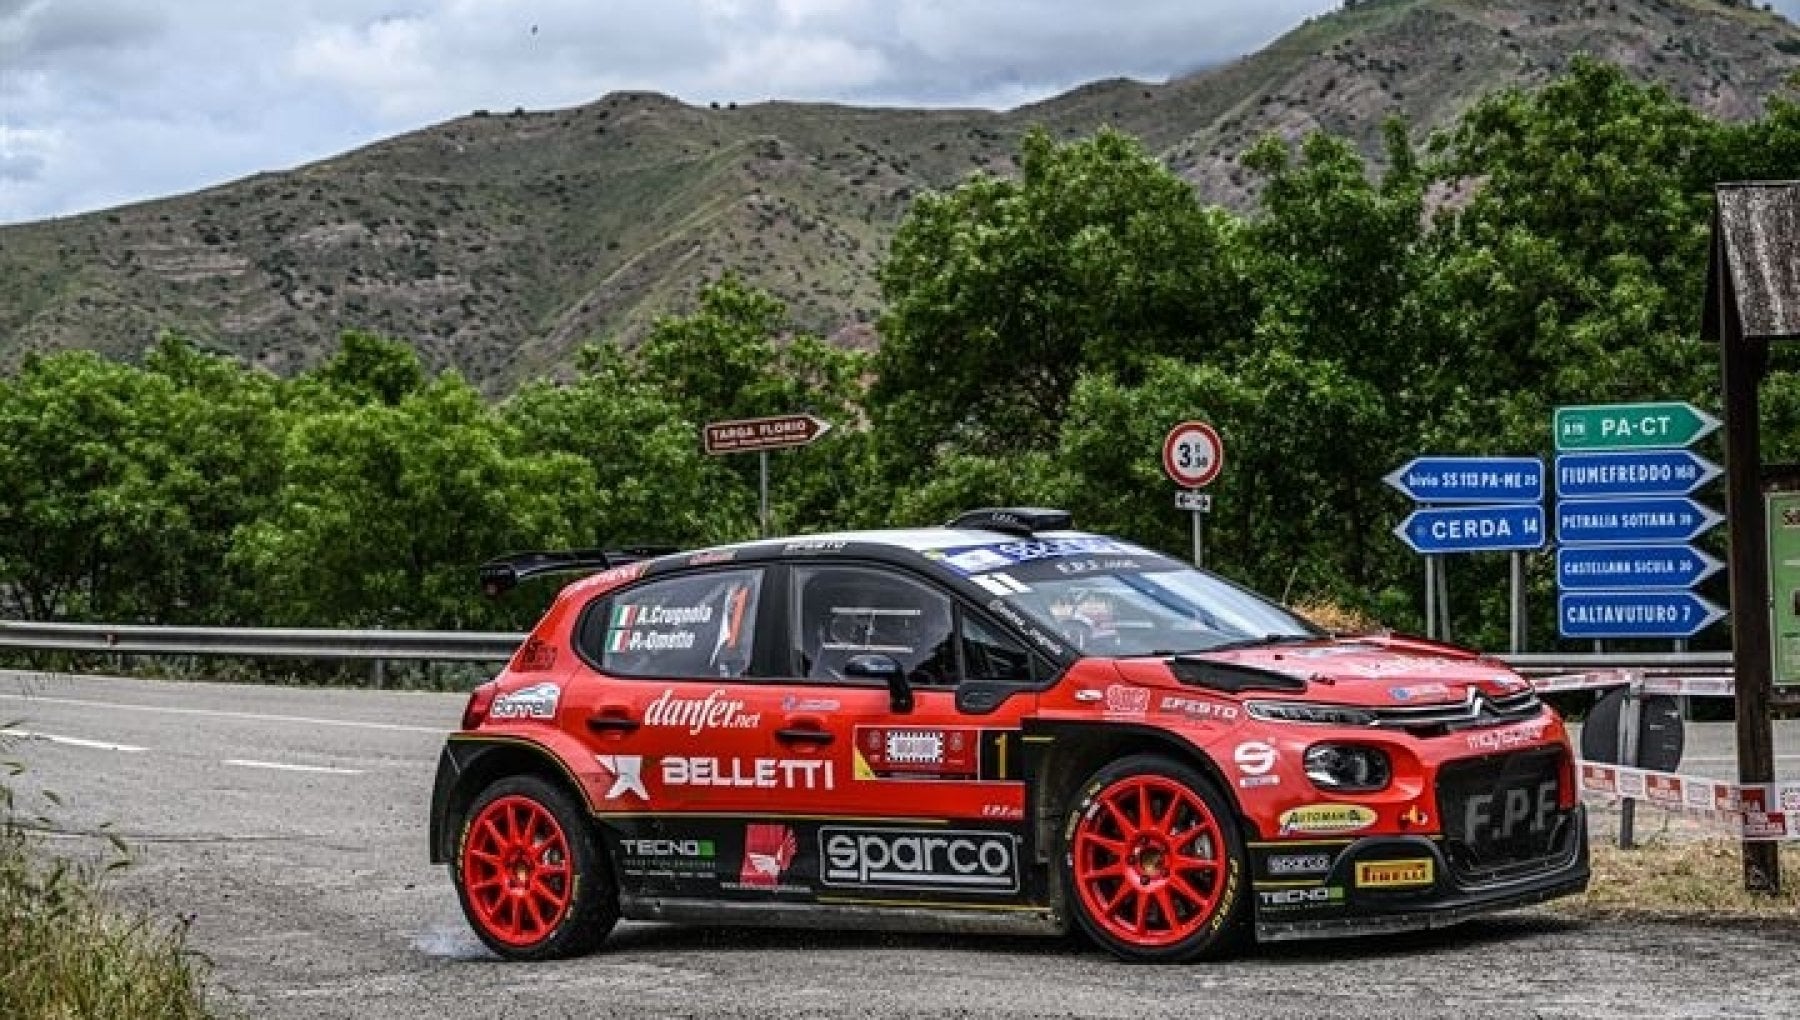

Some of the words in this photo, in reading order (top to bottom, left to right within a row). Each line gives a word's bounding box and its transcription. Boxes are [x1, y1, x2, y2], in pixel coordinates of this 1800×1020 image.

[711, 427, 755, 441] TARGA
[760, 420, 806, 436] FLORIO
[1602, 416, 1671, 438] PA-CT
[1441, 472, 1458, 488] SS
[1481, 471, 1522, 489] PA-ME
[1562, 464, 1671, 485] FIUMEFREDDO
[1432, 518, 1511, 540] CERDA
[1522, 517, 1538, 534] 14
[1562, 514, 1618, 529] PETRALIA
[1622, 512, 1676, 527] SOTTANA
[1564, 560, 1631, 576] CASTELLANA
[1634, 559, 1675, 574] SICULA
[1567, 604, 1678, 624] CALTAVUTURO
[1682, 604, 1691, 622] 7
[994, 732, 1008, 778] 1
[660, 756, 834, 791] BELLETTI
[827, 833, 1010, 884] sparco
